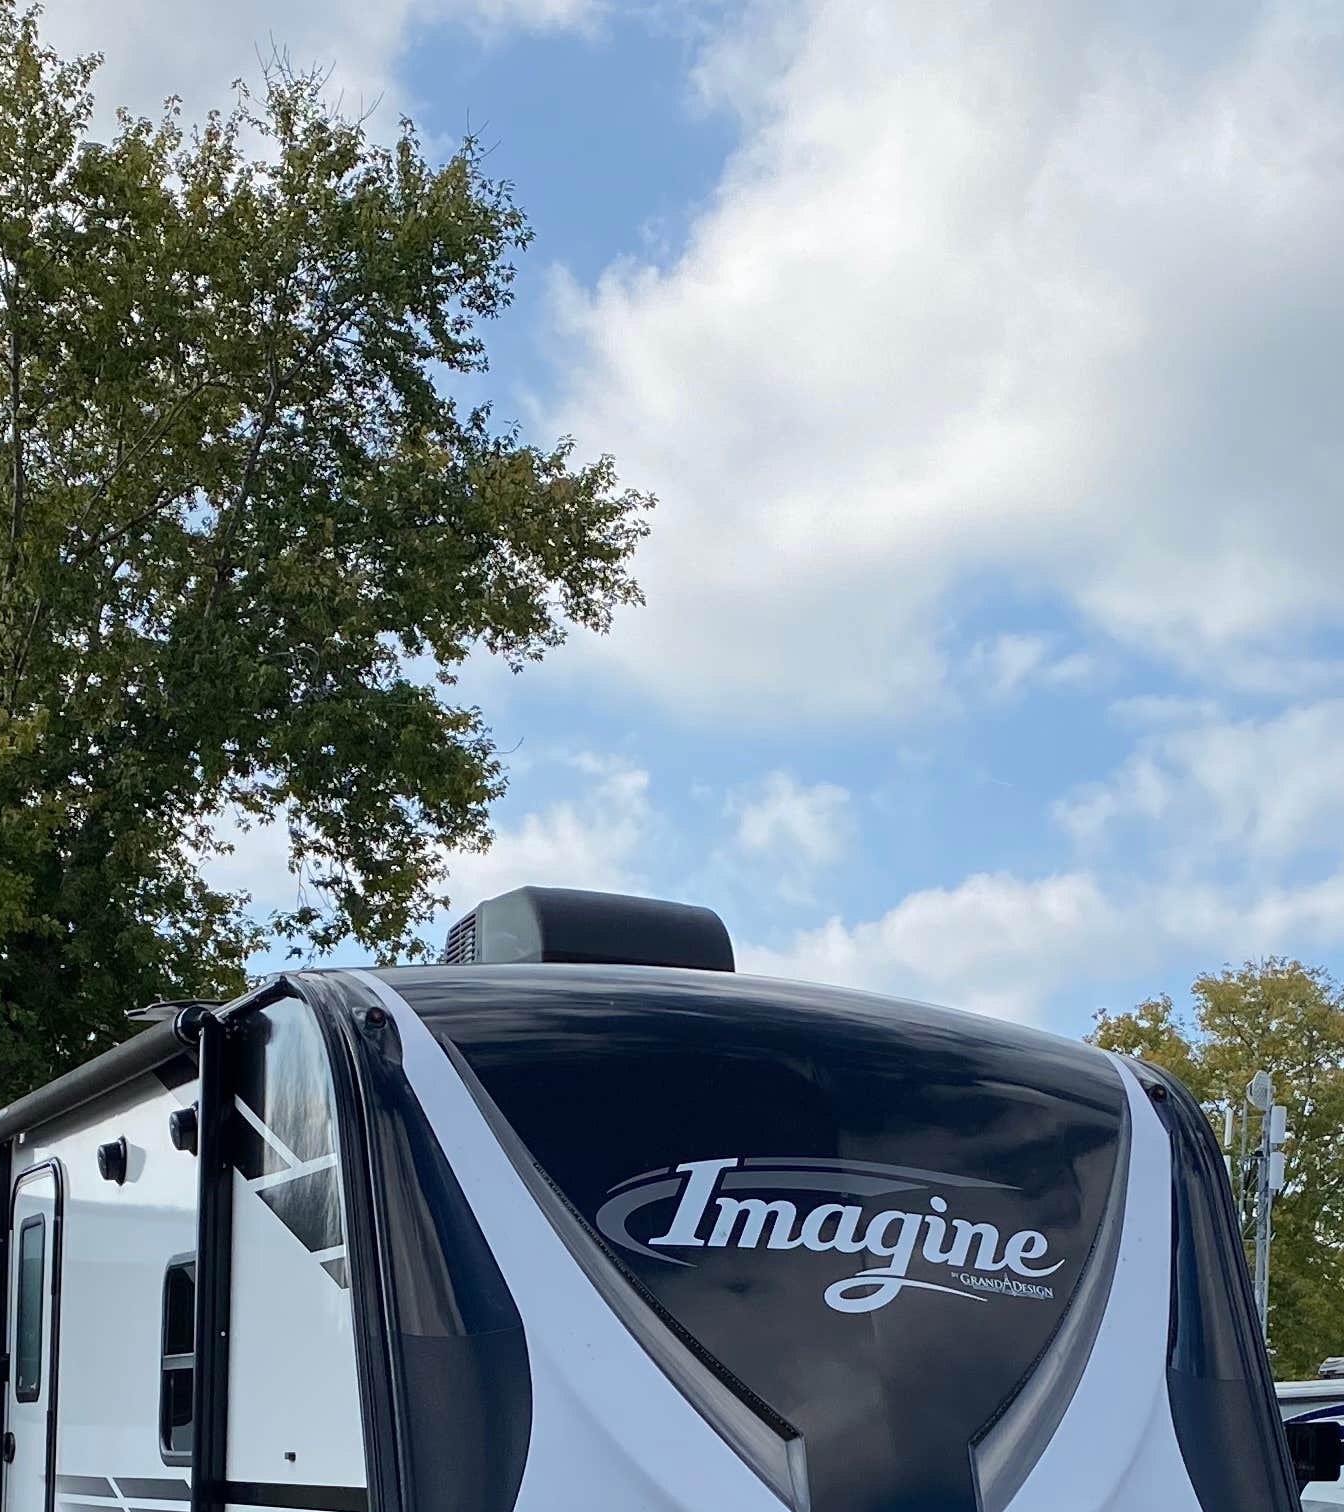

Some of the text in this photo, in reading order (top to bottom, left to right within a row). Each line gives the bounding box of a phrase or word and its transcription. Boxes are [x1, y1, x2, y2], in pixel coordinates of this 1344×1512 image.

[649, 1158, 1066, 1314] Imagine
[959, 1272, 1003, 1289] GRAND
[1012, 1280, 1055, 1298] DESIGN
